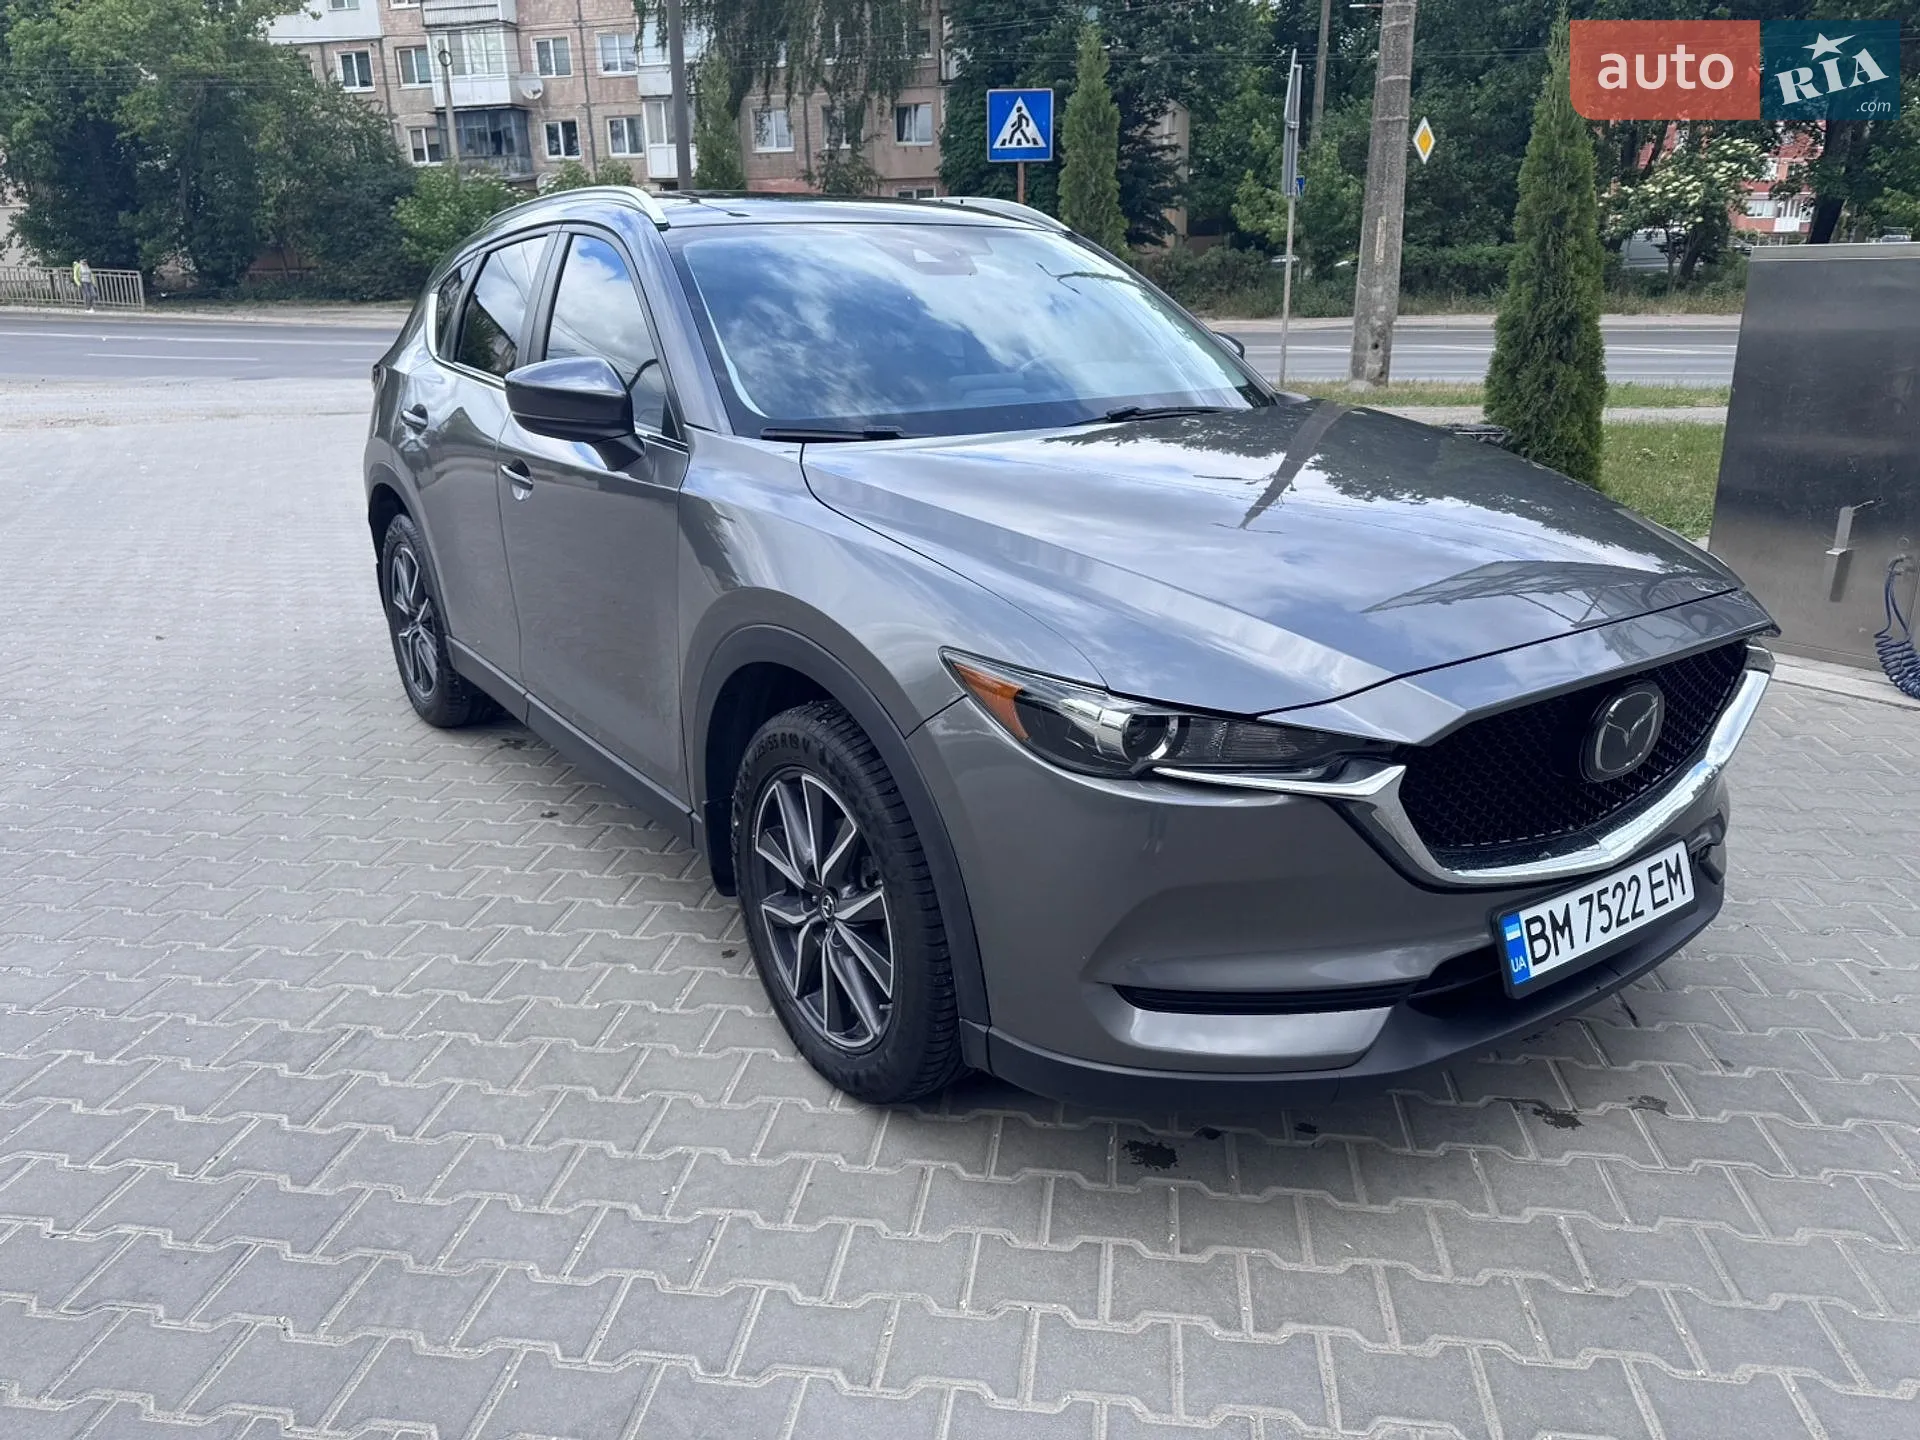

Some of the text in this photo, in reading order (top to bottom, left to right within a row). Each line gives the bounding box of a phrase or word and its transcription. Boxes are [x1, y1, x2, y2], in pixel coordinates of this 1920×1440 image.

[1524, 853, 1686, 966] BM 7522 EM
[1510, 955, 1527, 973] UA
